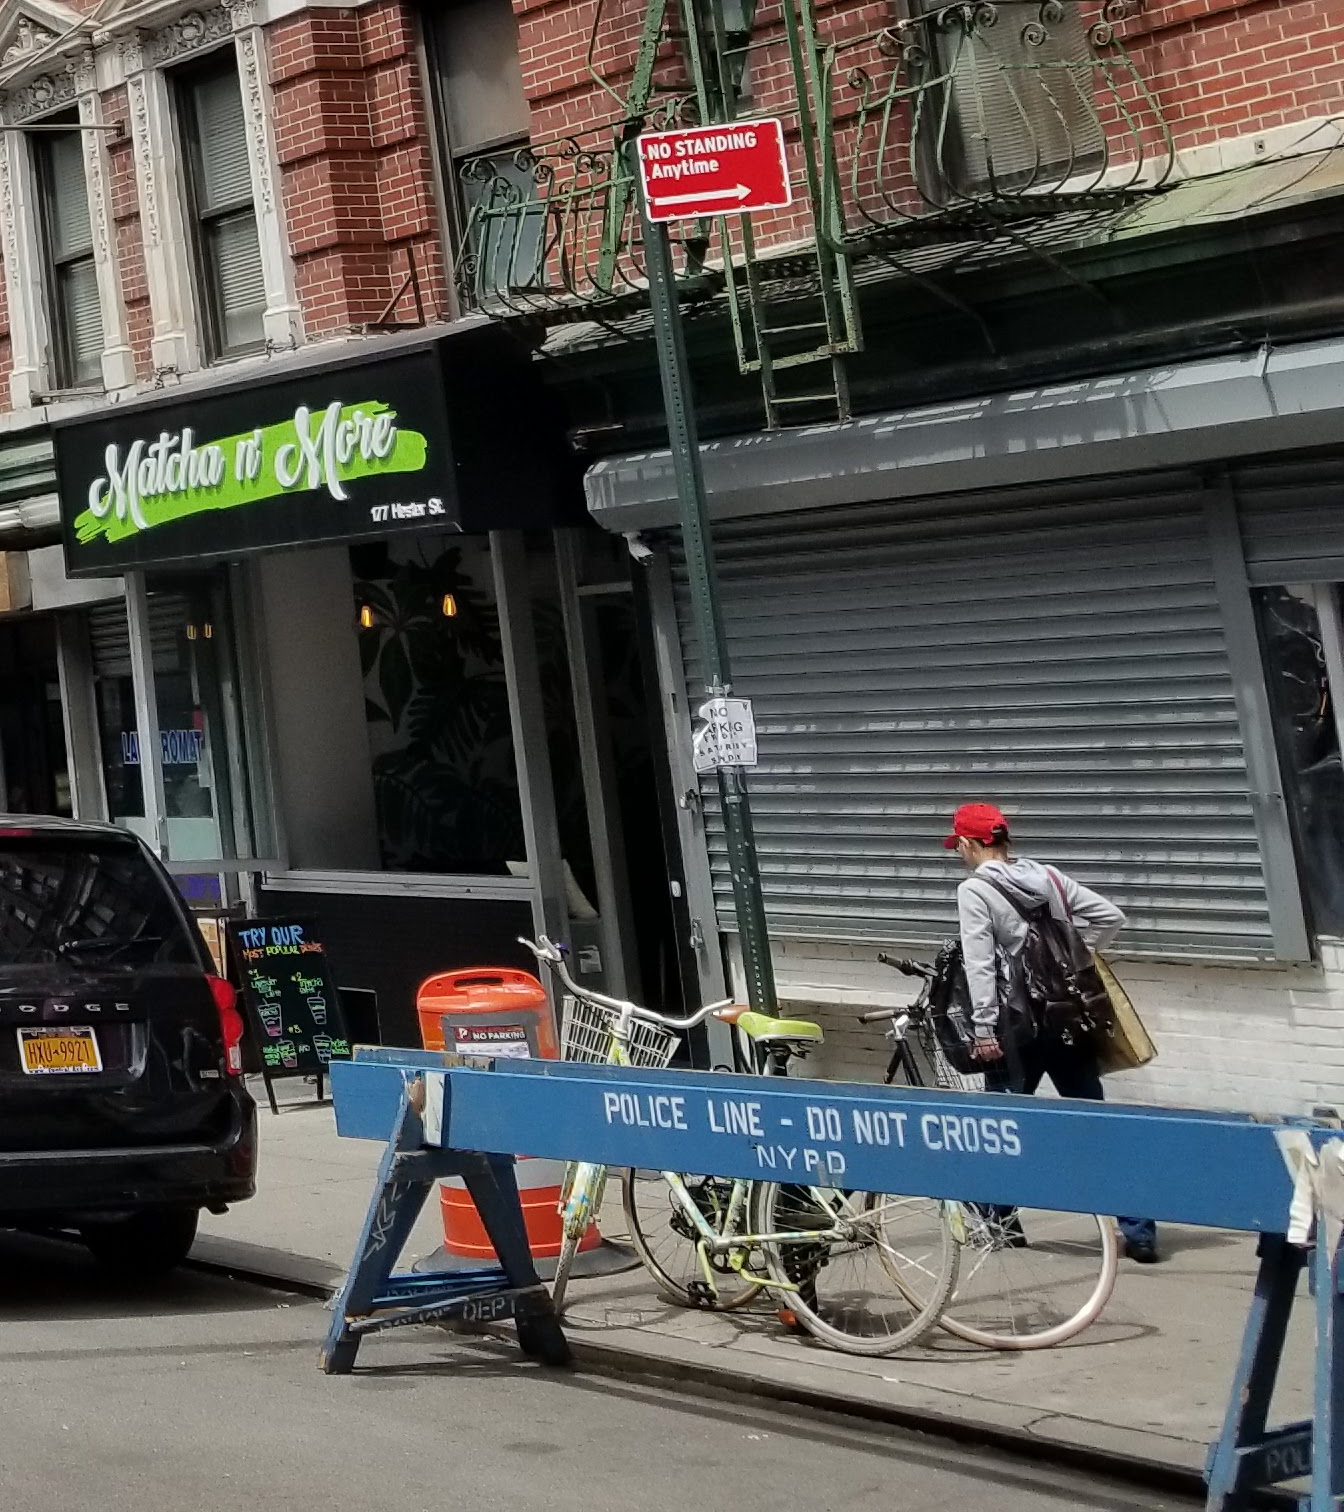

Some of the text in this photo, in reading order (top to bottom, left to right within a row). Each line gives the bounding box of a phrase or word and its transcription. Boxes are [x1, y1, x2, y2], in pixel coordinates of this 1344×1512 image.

[646, 131, 758, 160] NO STANDING
[651, 159, 720, 180] Anytime
[89, 427, 226, 530] Matcha
[274, 401, 398, 501] More
[391, 502, 426, 519] Hester
[709, 708, 728, 718] NO
[122, 730, 202, 764] LAROMAT
[238, 925, 305, 948] TRY OUR
[472, 1032, 487, 1040] NO
[488, 1031, 526, 1040] PARKING
[604, 1092, 687, 1131] POLICE
[708, 1099, 765, 1137] LINE
[807, 1106, 842, 1142] DO
[853, 1109, 908, 1148] NOT
[921, 1113, 1023, 1156] CROSS
[755, 1144, 847, 1175] NYPD
